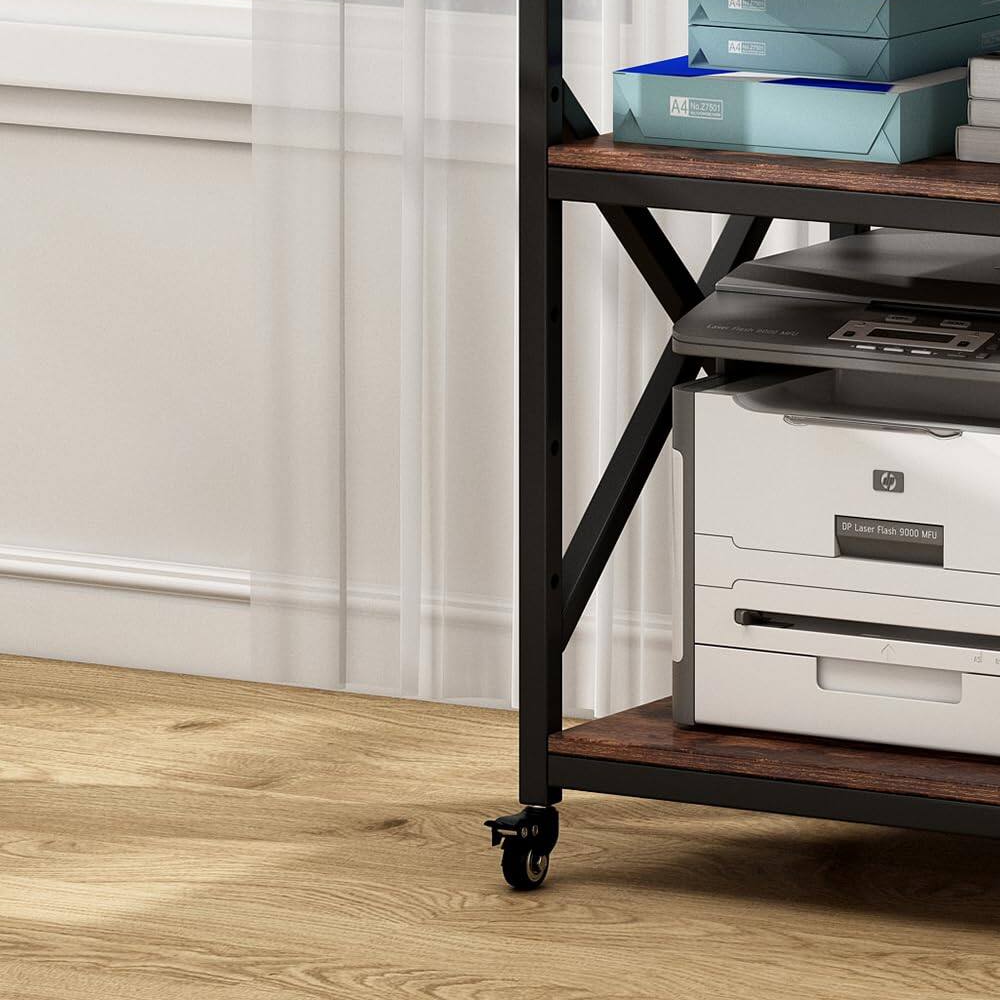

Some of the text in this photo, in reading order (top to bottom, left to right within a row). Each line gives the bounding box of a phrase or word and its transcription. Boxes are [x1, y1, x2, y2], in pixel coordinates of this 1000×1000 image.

[729, 41, 741, 53] A4
[671, 98, 688, 115] A4
[854, 524, 875, 534] Laser
[877, 525, 897, 536] Flash
[899, 528, 919, 538] 9000
[921, 529, 938, 540] MFU
